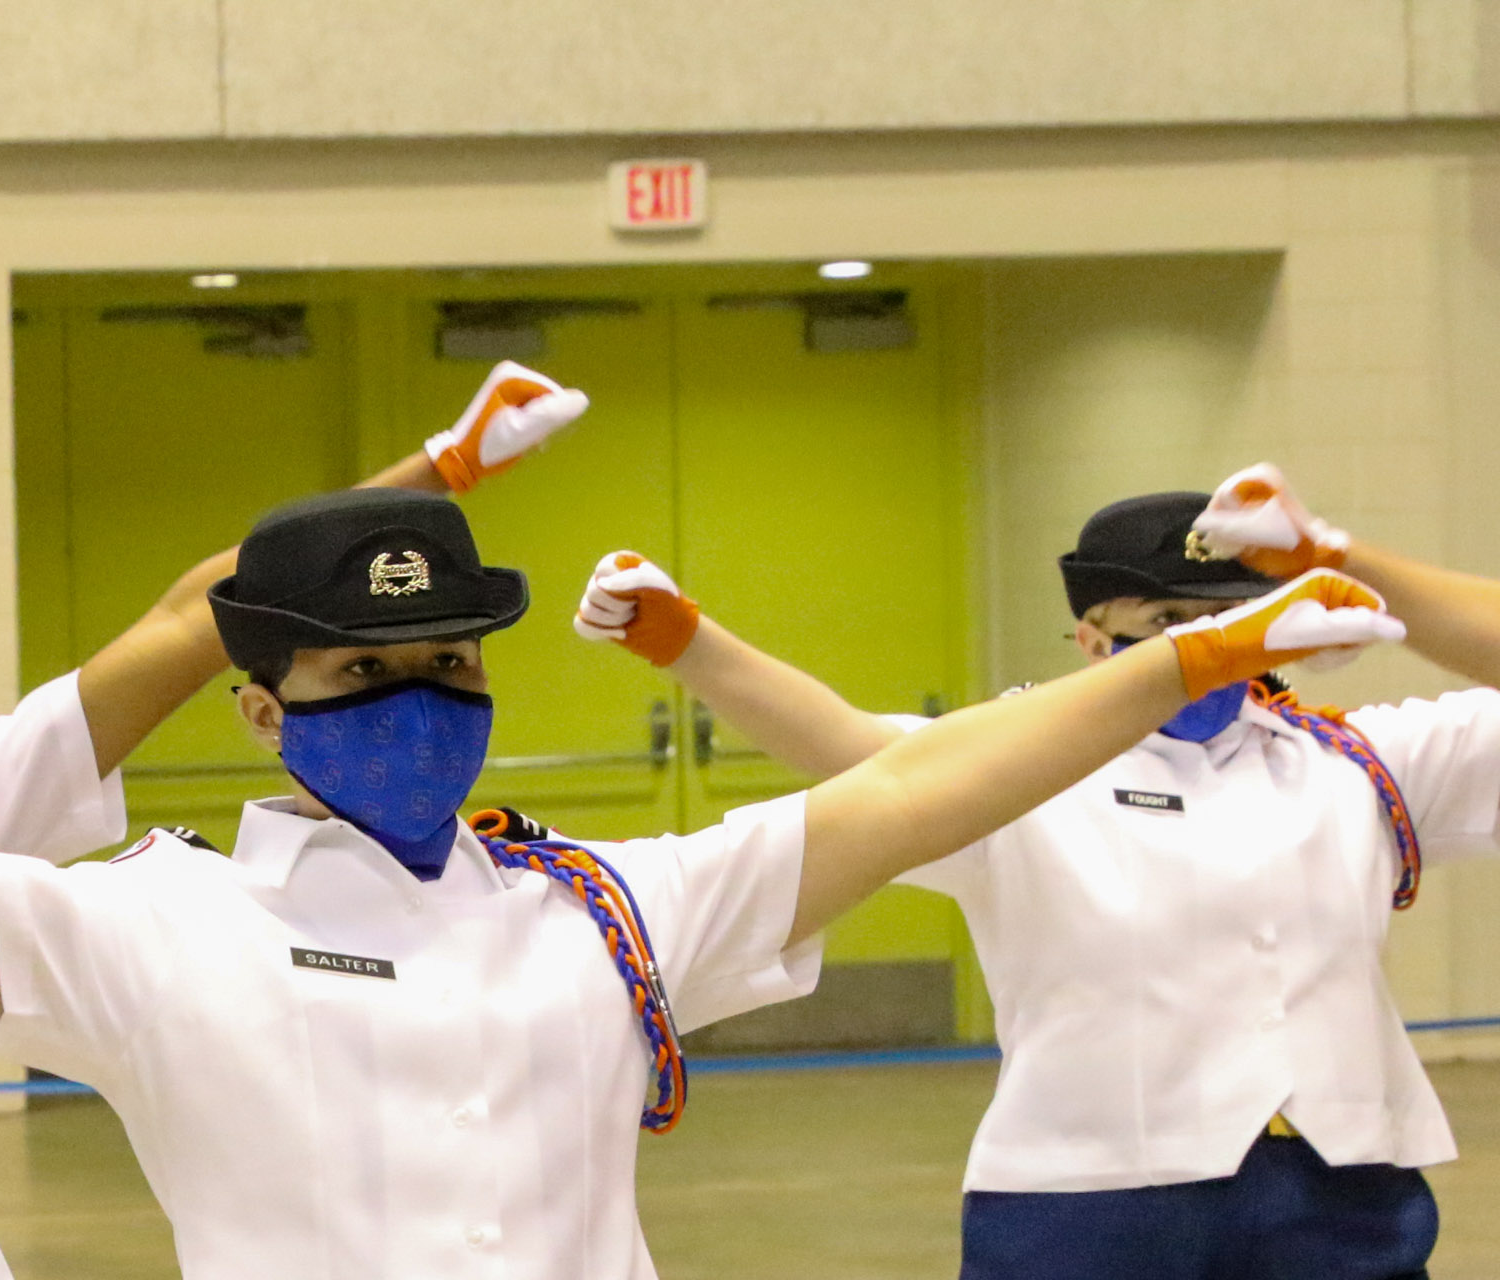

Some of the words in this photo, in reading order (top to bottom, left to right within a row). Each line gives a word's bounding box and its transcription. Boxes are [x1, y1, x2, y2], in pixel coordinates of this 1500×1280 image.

[626, 164, 693, 224] EXIT
[1128, 792, 1169, 808] FOUGHT
[305, 953, 379, 973] SALTER
